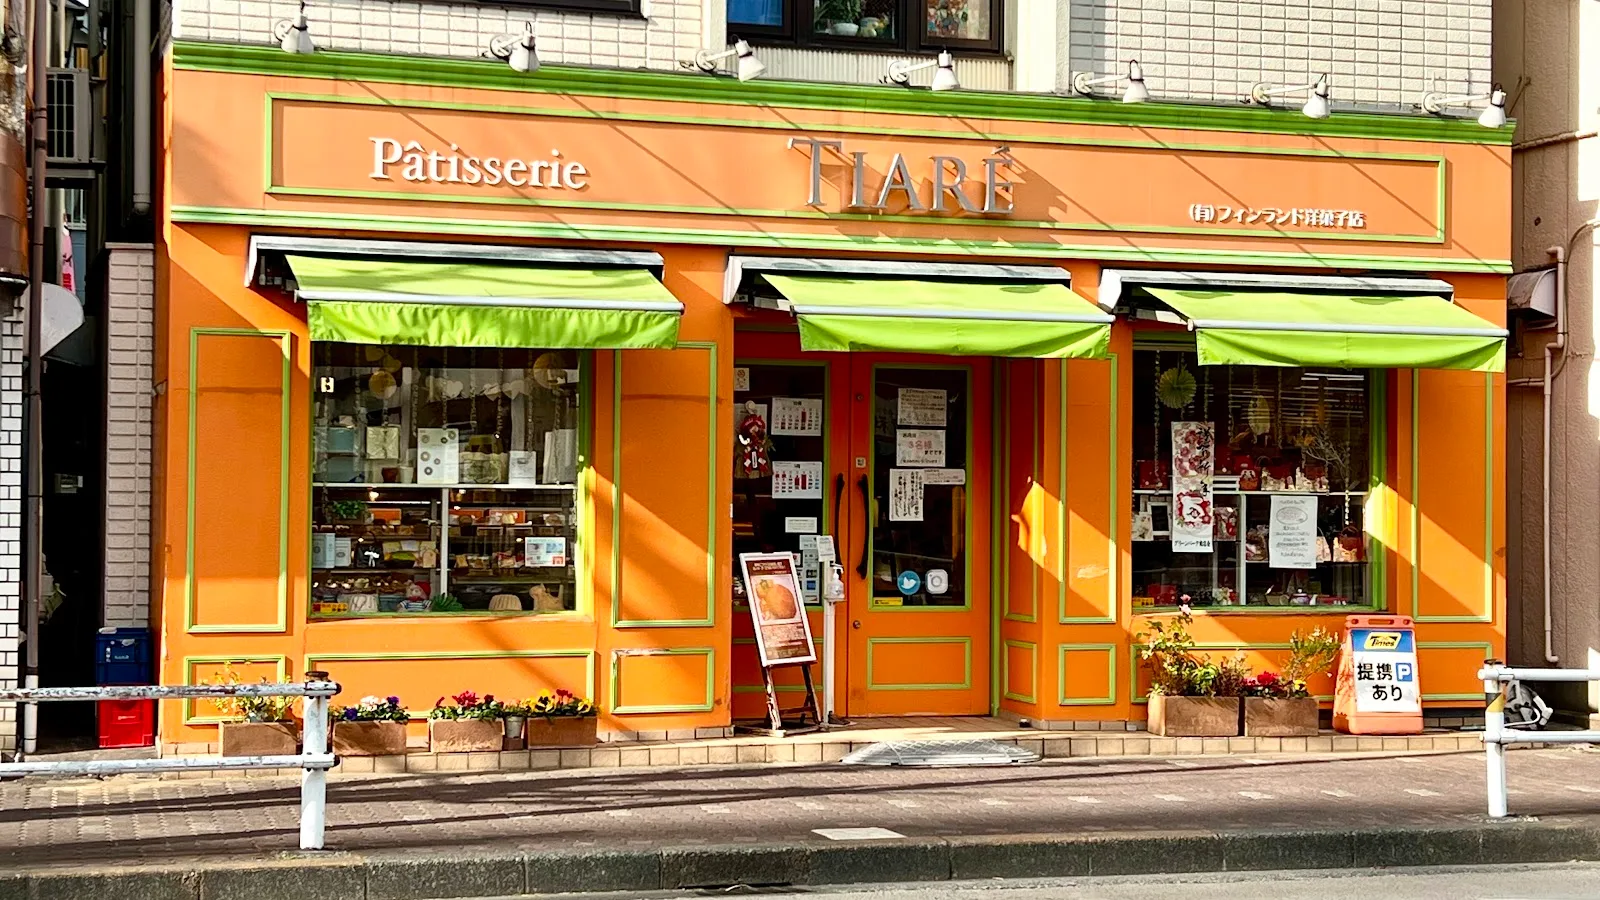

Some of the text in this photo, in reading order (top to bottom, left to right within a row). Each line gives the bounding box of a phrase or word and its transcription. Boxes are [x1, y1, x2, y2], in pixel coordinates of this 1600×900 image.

[368, 136, 589, 190] Pâtisserie
[786, 136, 1014, 215] TIARÉ
[1369, 635, 1399, 648] Times
[1357, 662, 1393, 681] 提携
[1372, 684, 1403, 701] あり
